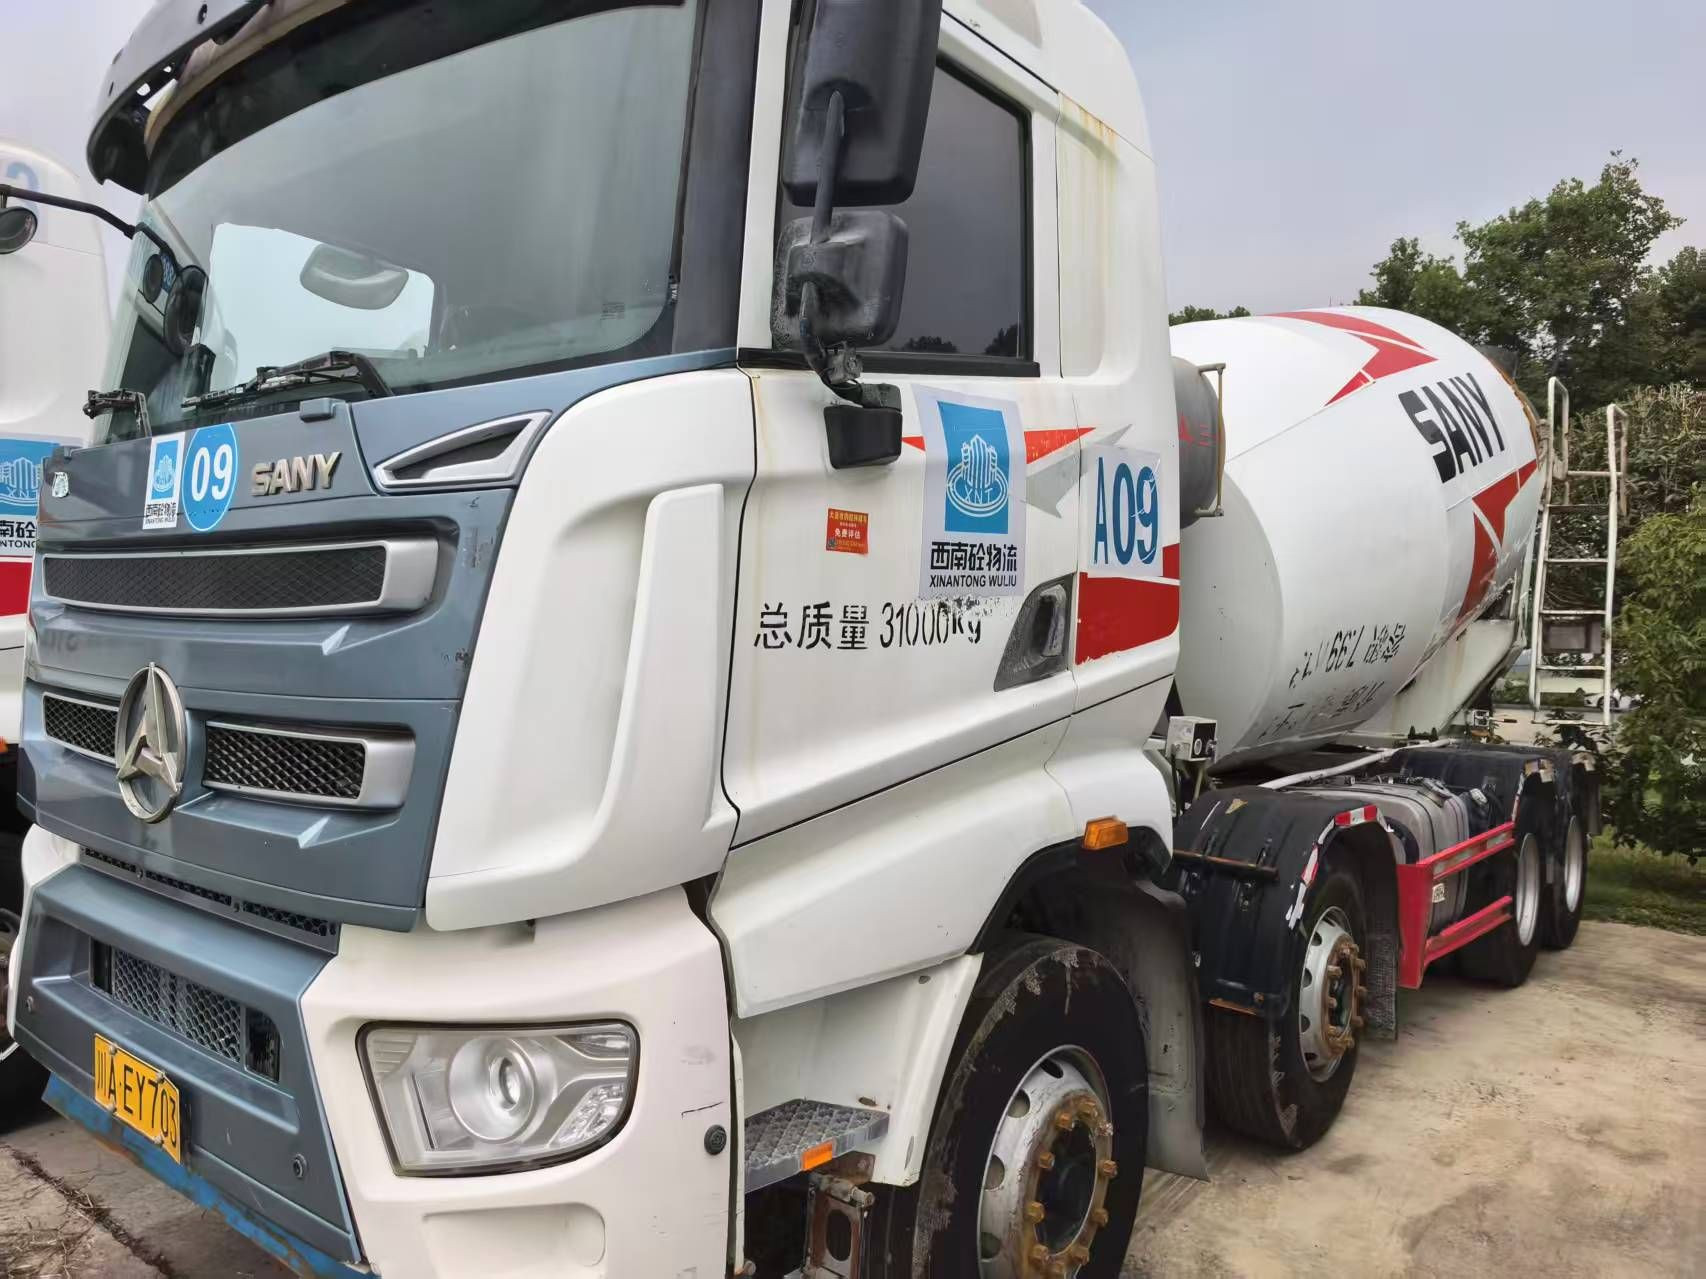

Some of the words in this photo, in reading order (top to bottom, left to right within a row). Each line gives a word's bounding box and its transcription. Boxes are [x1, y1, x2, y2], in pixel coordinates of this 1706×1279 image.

[1398, 372, 1505, 484] SANY
[191, 443, 233, 502] 09
[252, 451, 342, 497] SANY
[963, 484, 994, 505] XNT
[1094, 456, 1159, 565] A09
[930, 541, 1018, 572] 西南砼物流
[929, 574, 986, 588] XINANTONG
[988, 574, 1018, 588] WULIU
[753, 601, 870, 650] 总质量
